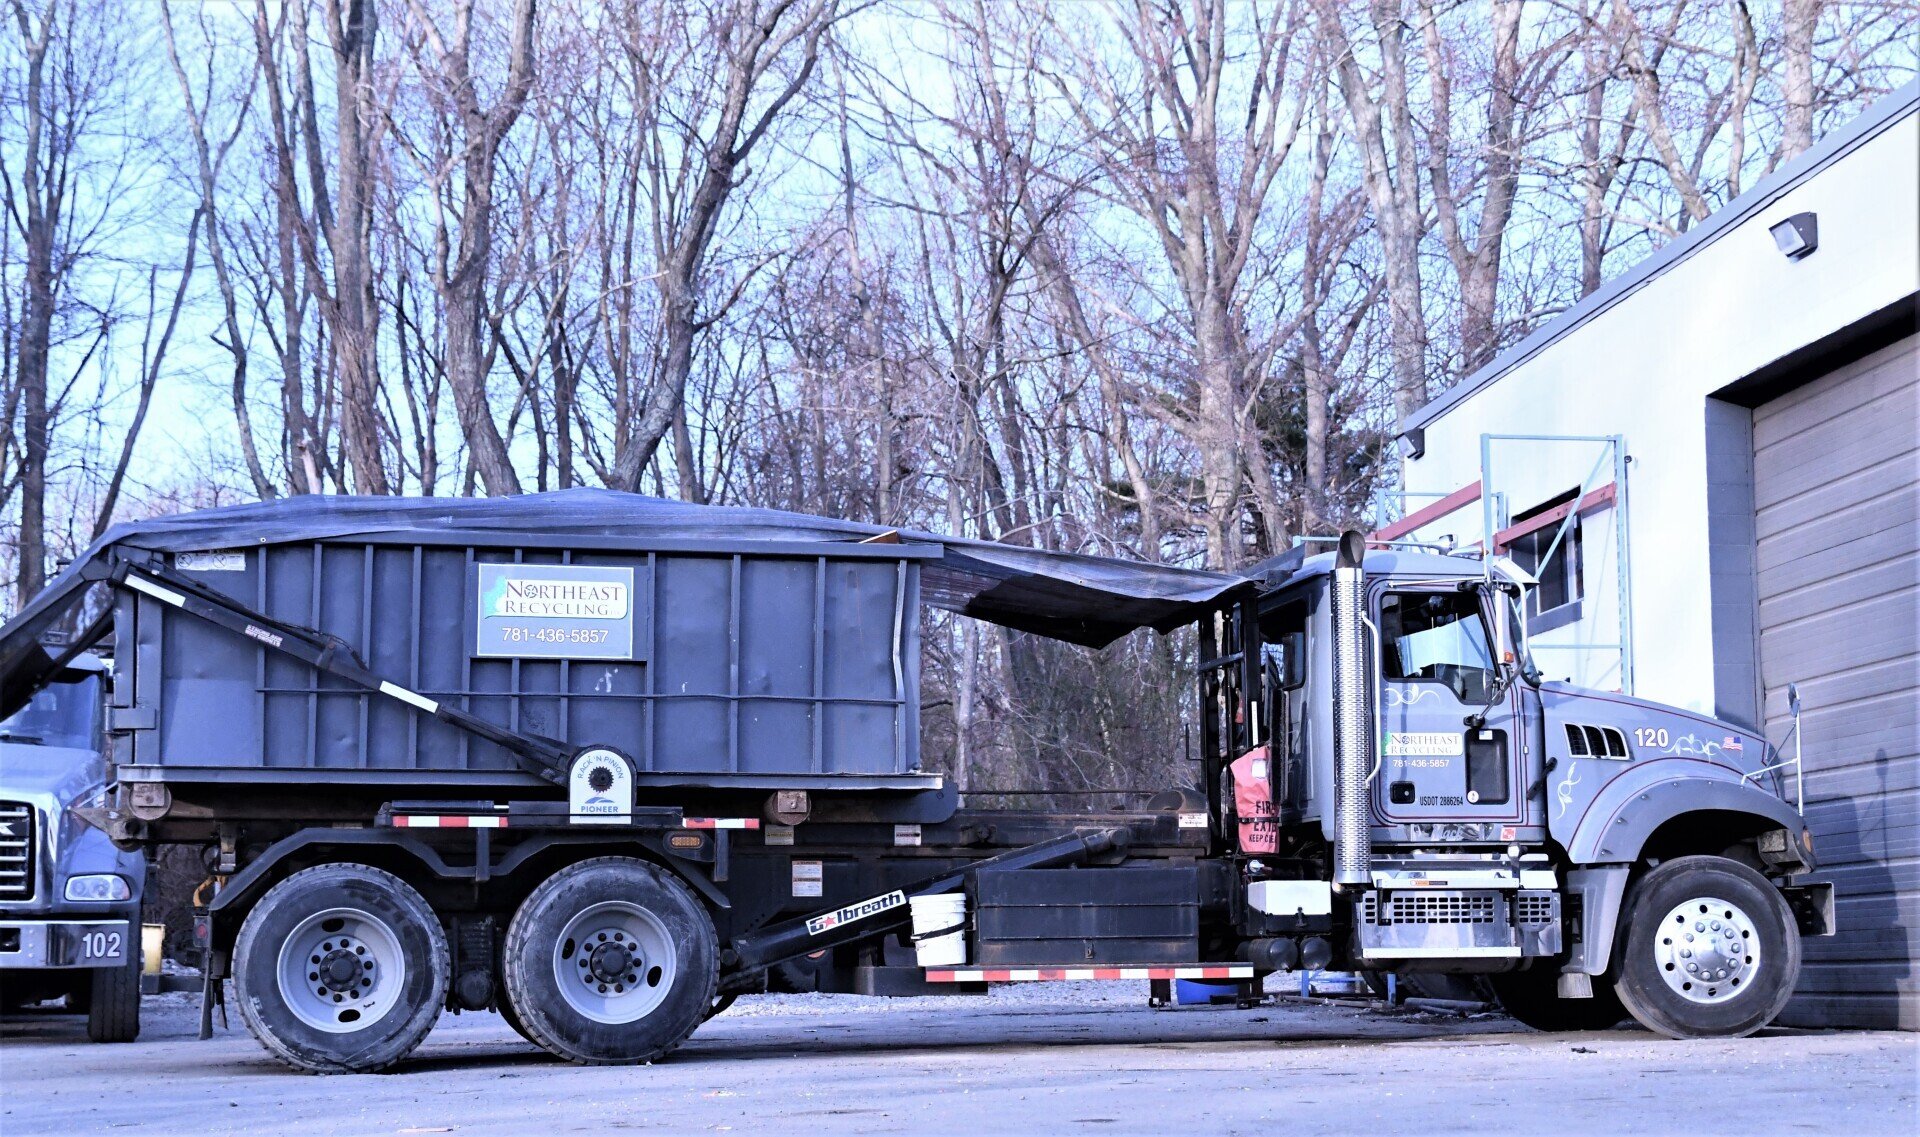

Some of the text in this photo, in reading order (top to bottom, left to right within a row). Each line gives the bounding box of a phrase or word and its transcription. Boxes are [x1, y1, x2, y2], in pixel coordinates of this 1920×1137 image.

[506, 581, 622, 601] NORTHEAST
[505, 601, 608, 616] RECYCLING
[502, 628, 609, 643] 781-436-5857
[1391, 734, 1460, 745] NORTHEAST
[1634, 728, 1669, 748] 120
[1391, 746, 1452, 754] RECYCLING
[578, 755, 593, 779] RACK
[604, 756, 624, 779] PINION
[1392, 759, 1450, 768] 781-436-5857
[1419, 796, 1439, 806] USDOT
[581, 805, 619, 813] PIONEER
[1248, 834, 1264, 843] KEEP
[82, 932, 121, 958] 102
